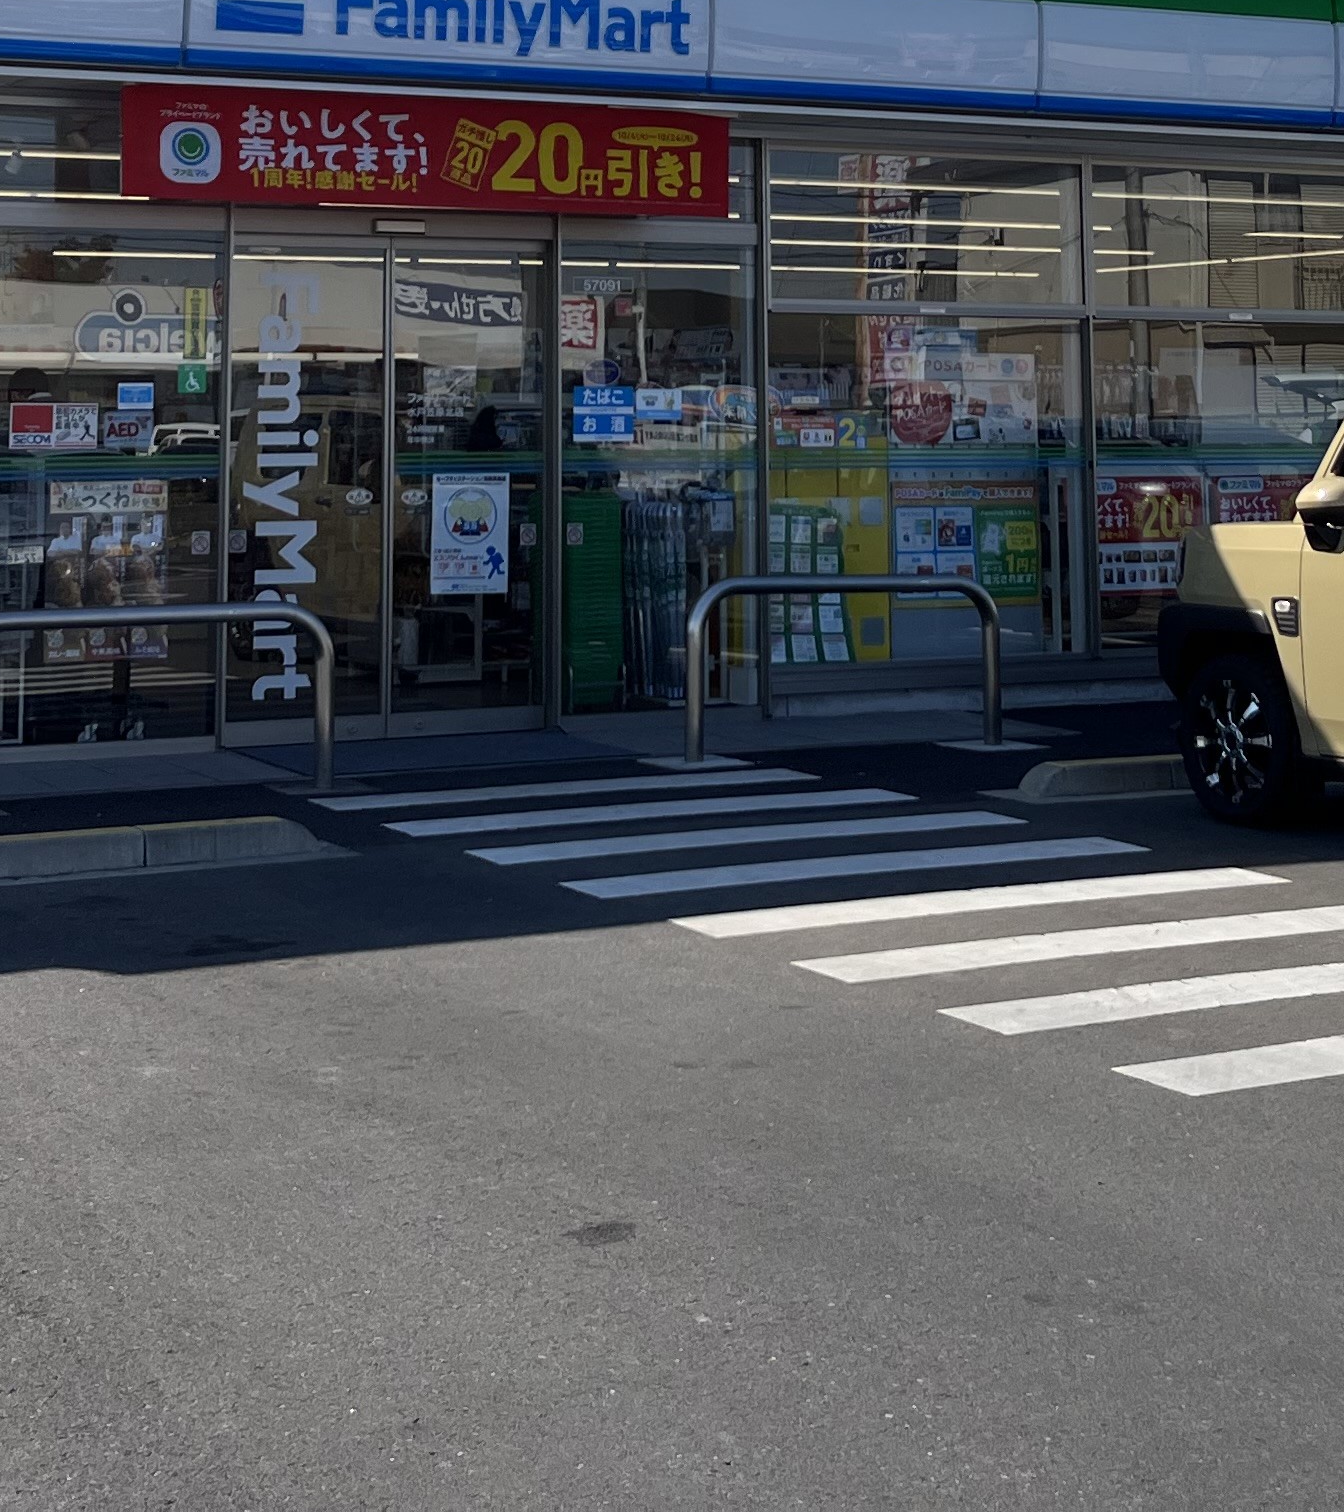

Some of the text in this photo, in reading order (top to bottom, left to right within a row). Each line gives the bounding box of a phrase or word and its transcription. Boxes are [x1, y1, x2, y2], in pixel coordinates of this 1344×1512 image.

[239, 104, 425, 143] おいしくて、
[172, 167, 209, 178] ファミマル
[583, 278, 622, 292] 57091
[925, 358, 998, 373] POSAカード
[582, 389, 625, 405] たばこ
[106, 421, 139, 438] AED
[12, 434, 51, 444] SECOM
[1229, 479, 1262, 490] ファミマル
[1219, 495, 1277, 510] おいしくて、
